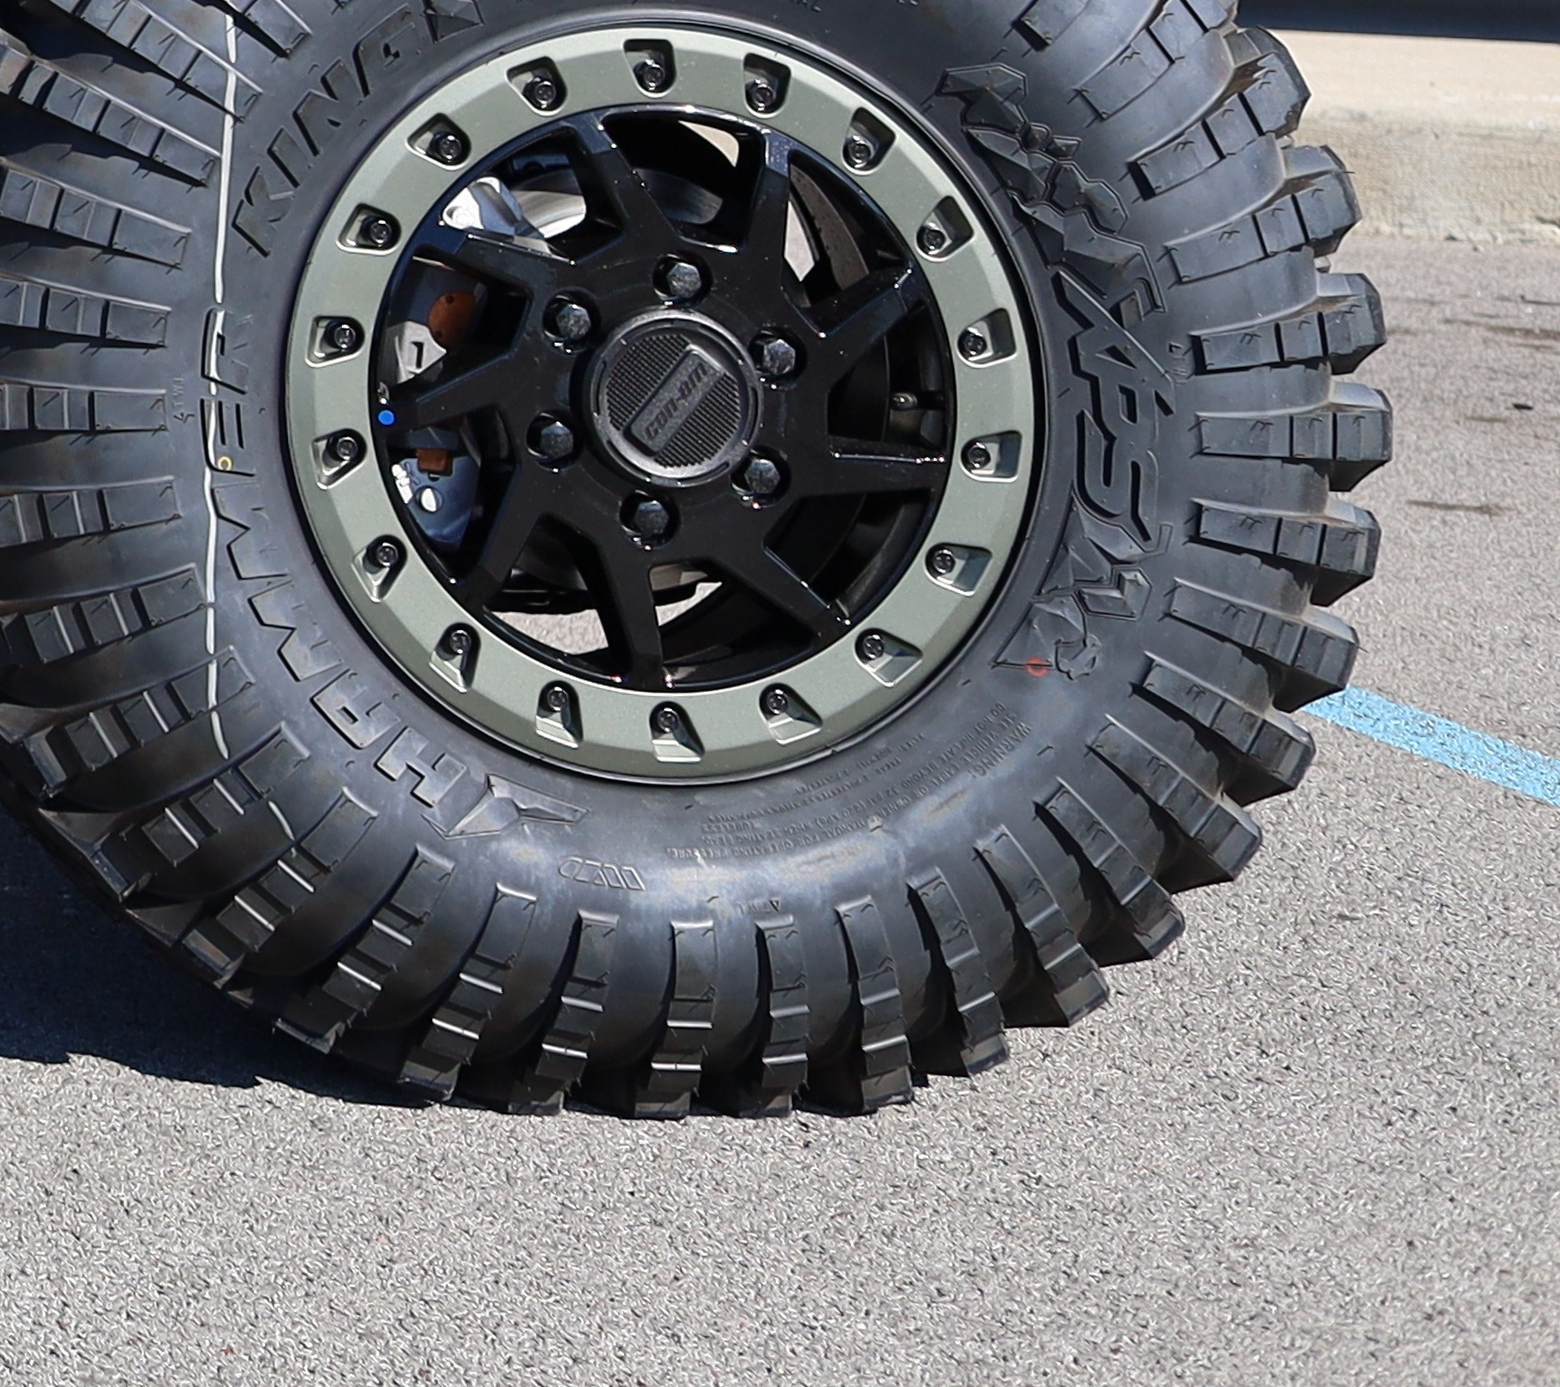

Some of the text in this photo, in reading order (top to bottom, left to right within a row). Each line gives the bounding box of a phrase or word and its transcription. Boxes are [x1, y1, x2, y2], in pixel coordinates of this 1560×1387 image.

[200, 3, 467, 808] HAMMER KING
[967, 718, 1033, 782] WARNING:
